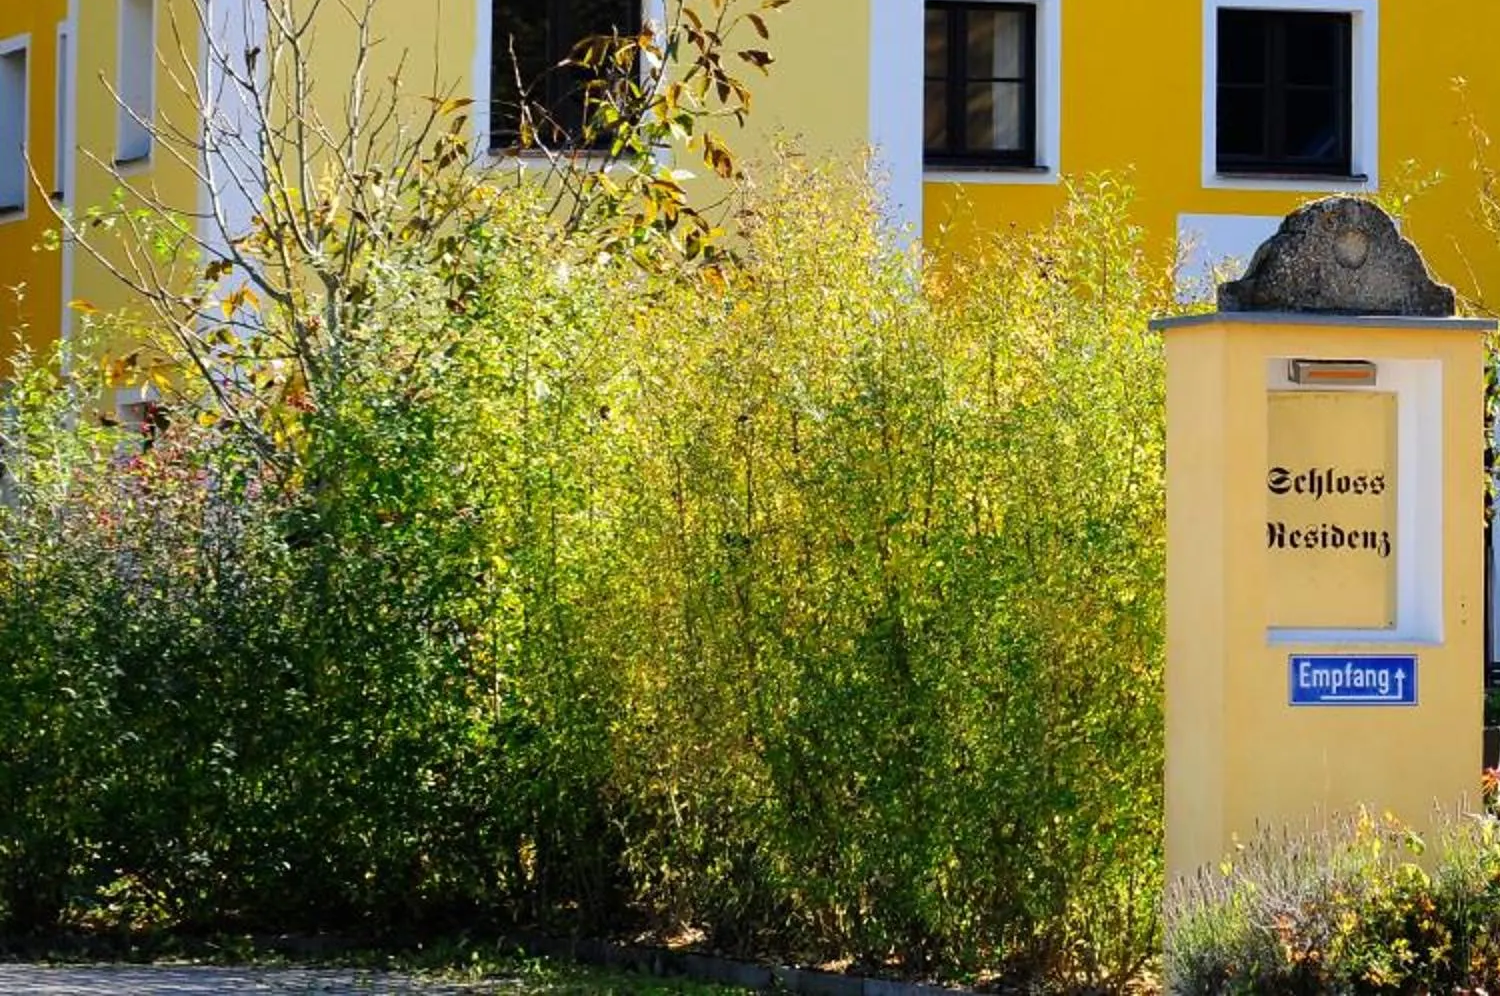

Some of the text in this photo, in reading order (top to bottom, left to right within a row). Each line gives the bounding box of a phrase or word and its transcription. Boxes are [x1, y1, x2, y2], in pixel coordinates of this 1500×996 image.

[1267, 467, 1385, 500] Schloss
[1267, 522, 1391, 558] Residenz
[1299, 662, 1389, 694] Empfang
